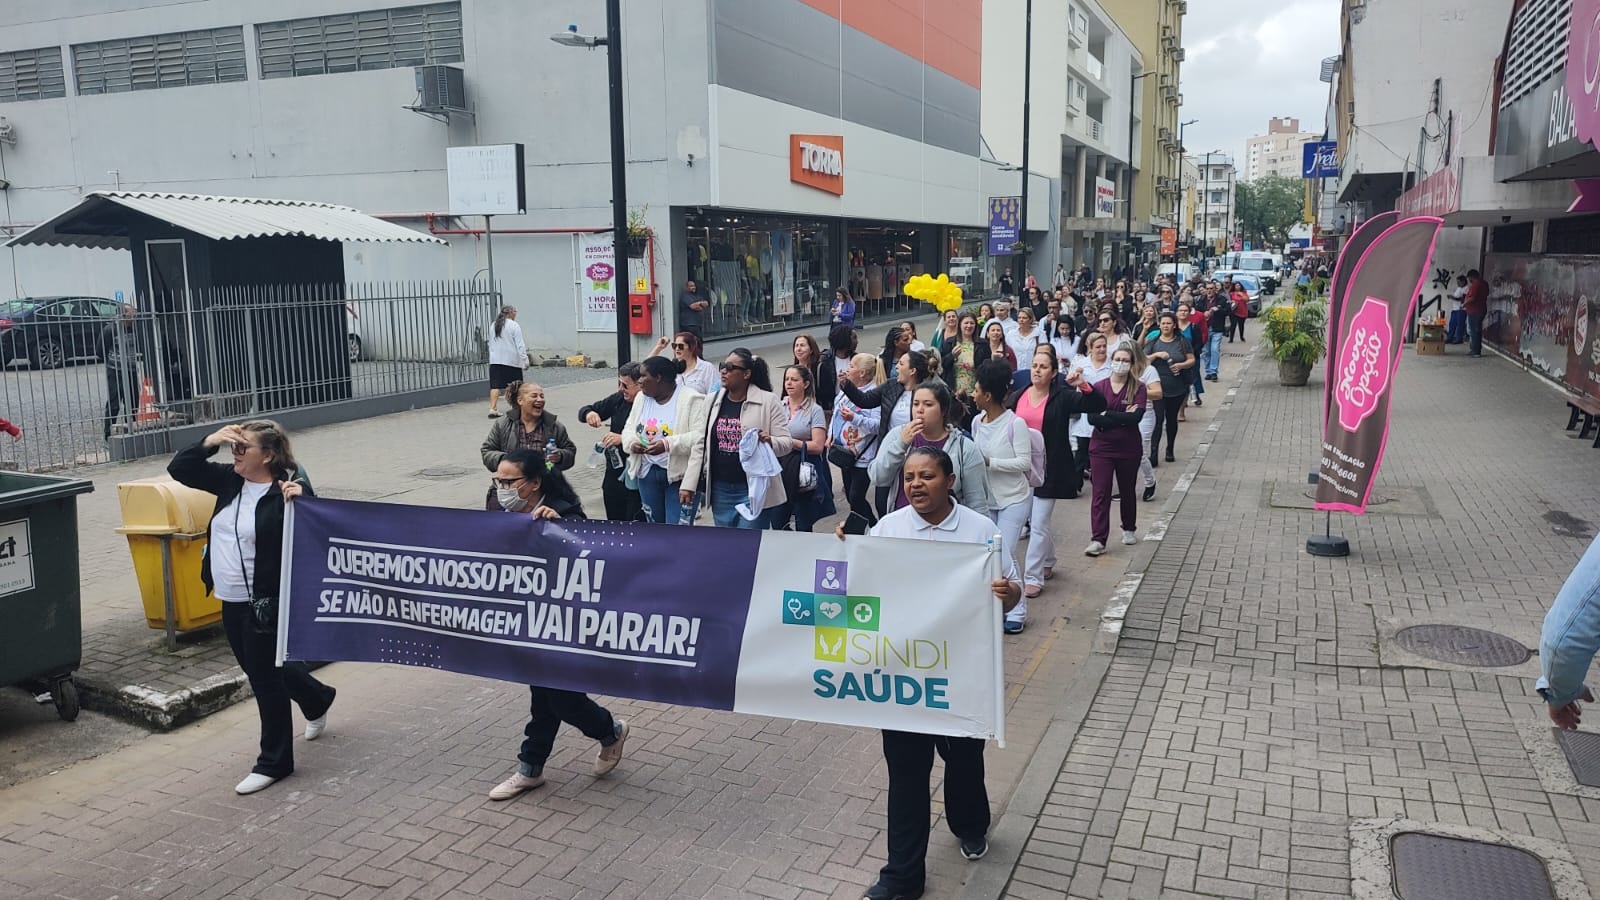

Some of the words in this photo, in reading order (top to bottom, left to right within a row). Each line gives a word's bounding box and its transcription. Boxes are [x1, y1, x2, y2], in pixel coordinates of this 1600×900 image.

[1547, 86, 1578, 148] BAZA
[799, 141, 843, 177] TORRA
[1340, 327, 1366, 401] Nova
[1350, 331, 1382, 407] Opção
[327, 546, 426, 584] QUEREMOS
[427, 558, 498, 592] NOSSO
[498, 564, 547, 597] PISO
[550, 550, 606, 603] JÁ!
[316, 589, 345, 613] SE
[345, 589, 384, 616] NÃO
[386, 596, 399, 618] A
[400, 599, 523, 636] ENFERMAGEM
[527, 600, 574, 643] VAI
[578, 608, 701, 657] PARAR!
[850, 633, 948, 670] SINDI
[812, 668, 950, 710] SAÚDE
